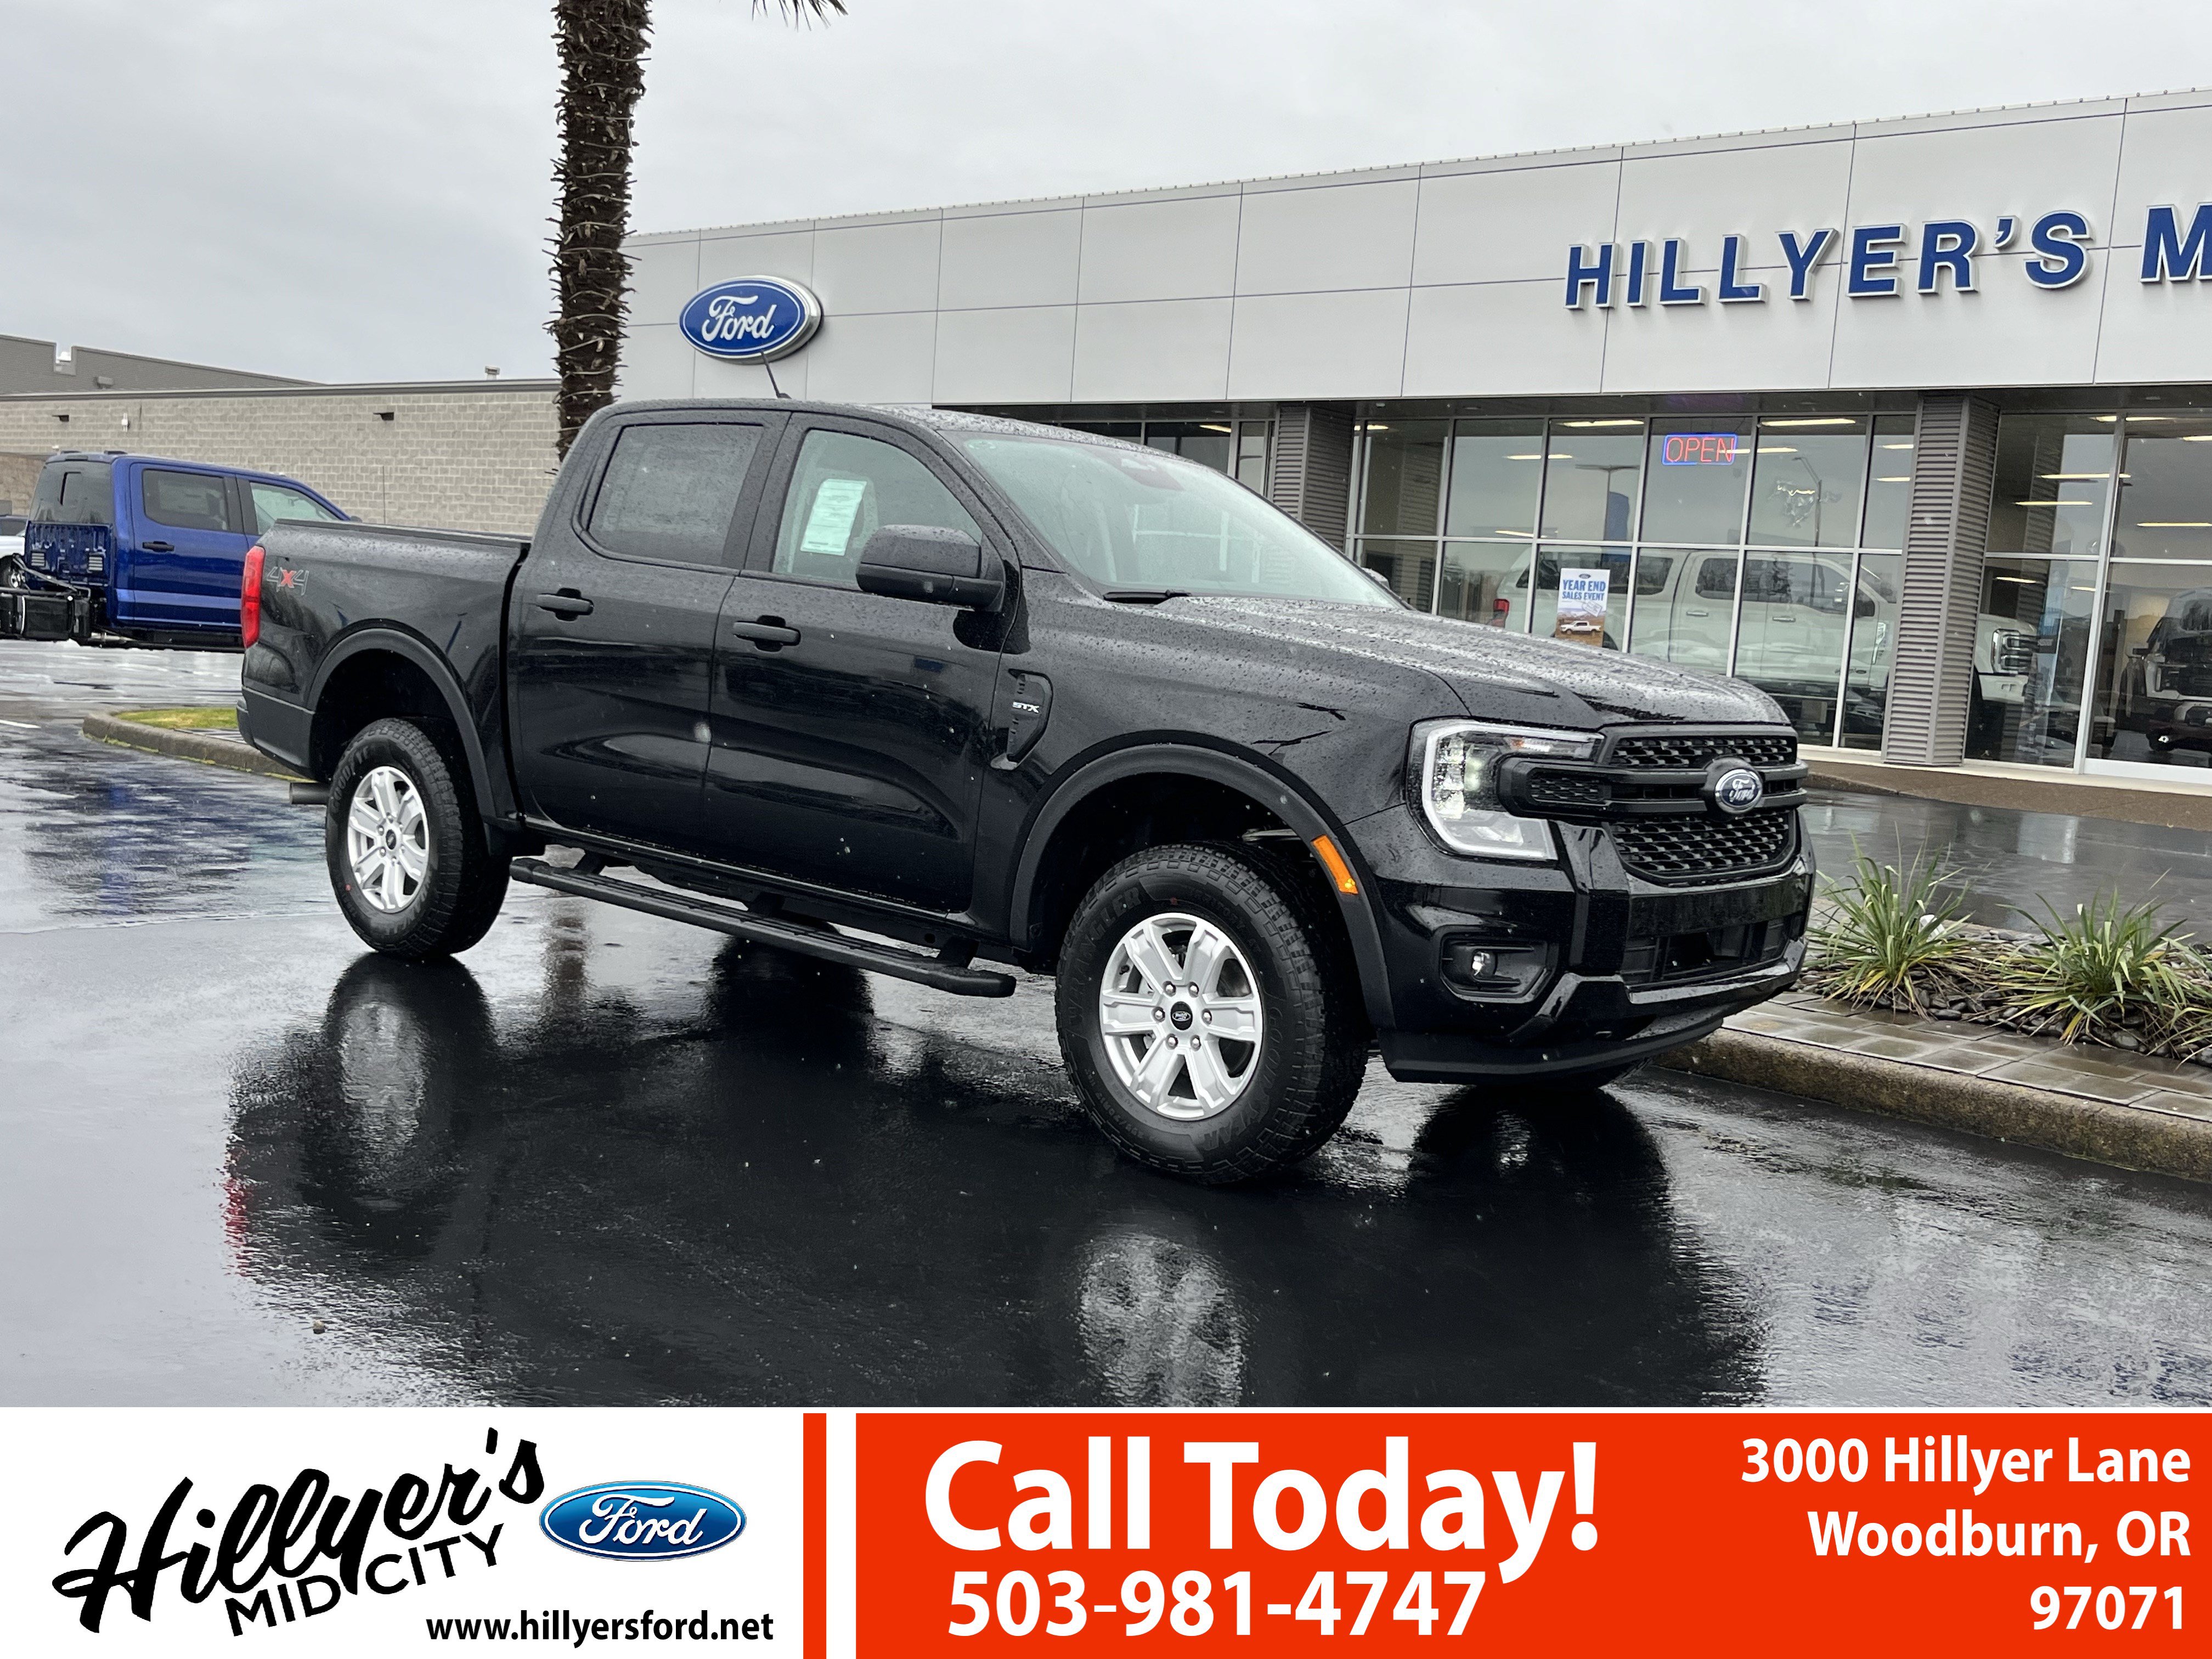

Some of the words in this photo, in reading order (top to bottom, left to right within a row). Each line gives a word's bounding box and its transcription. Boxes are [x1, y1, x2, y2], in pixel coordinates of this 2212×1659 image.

[702, 295, 777, 341] Ford
[1666, 437, 1734, 462] OPEN
[1562, 580, 1585, 591] YEAR
[1588, 581, 1606, 591] END
[1562, 591, 1582, 600] SALES
[1012, 702, 1040, 713] STX
[1729, 778, 1756, 802] Ford
[1067, 886, 1142, 1019] WRANGLER
